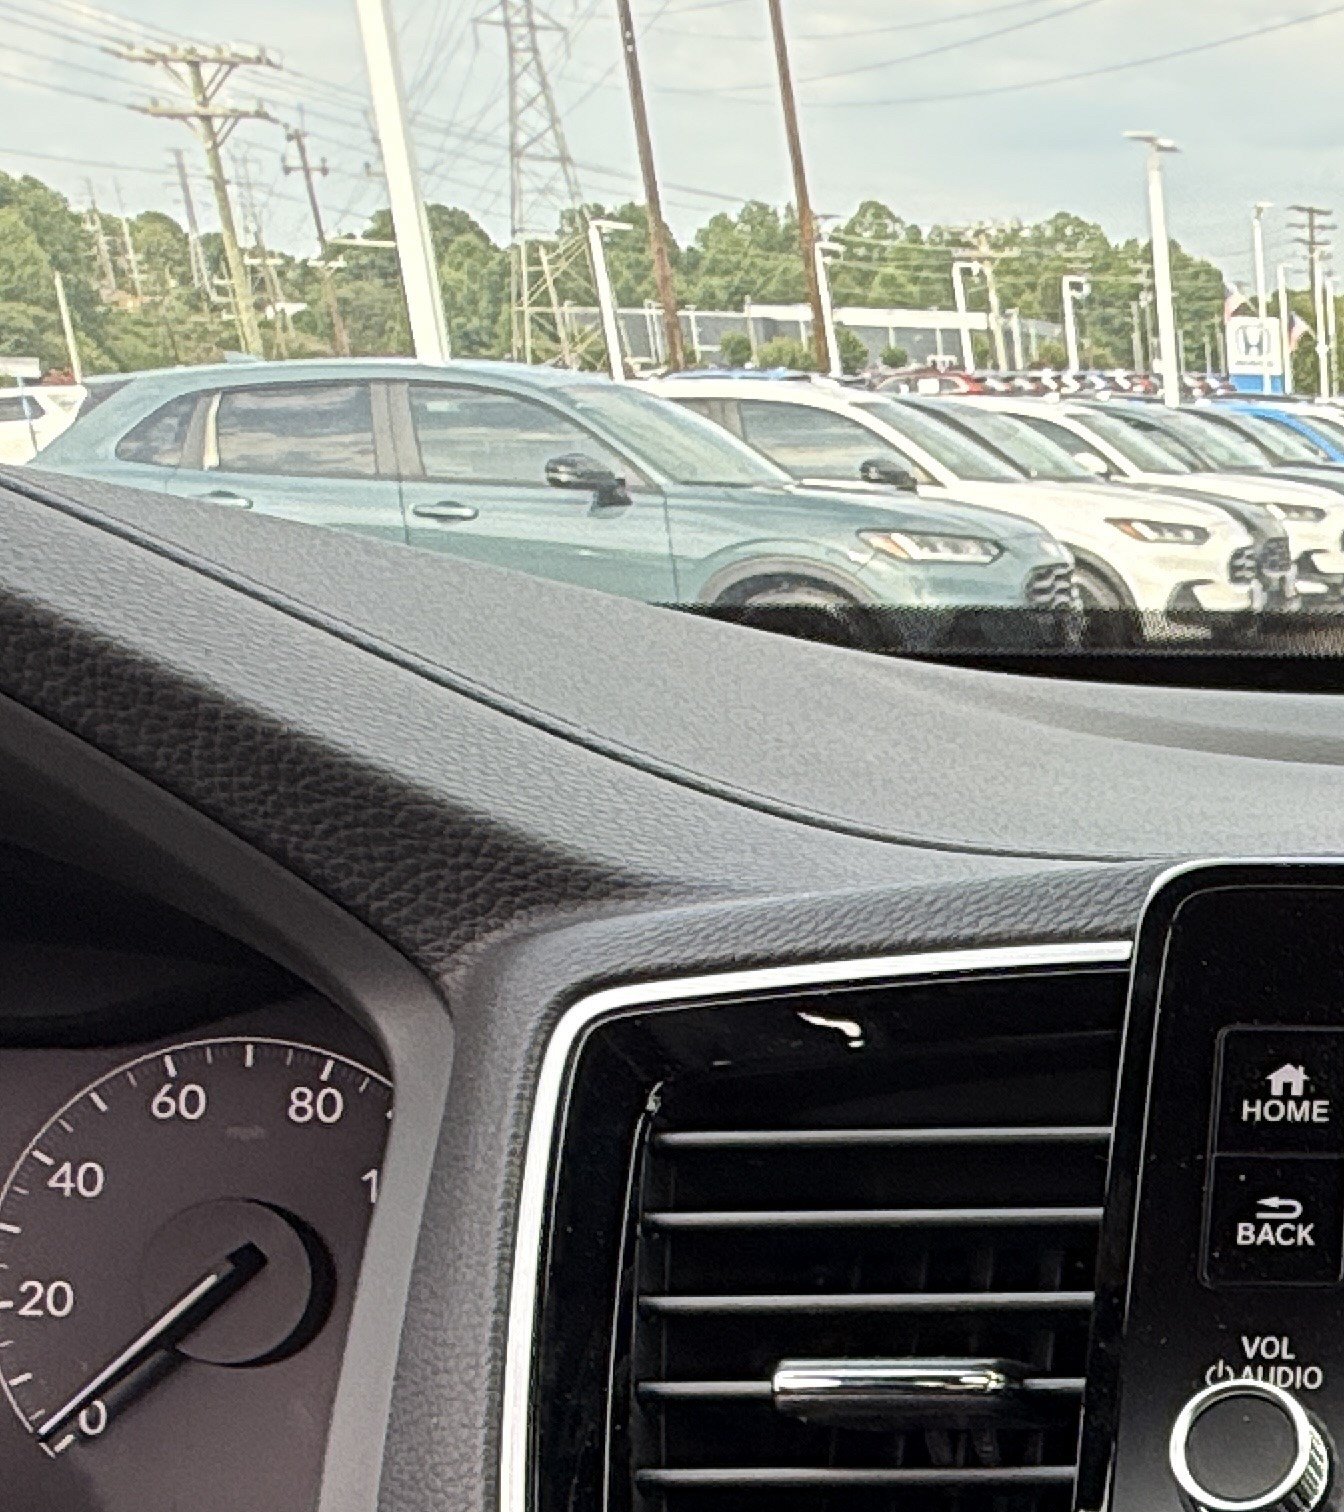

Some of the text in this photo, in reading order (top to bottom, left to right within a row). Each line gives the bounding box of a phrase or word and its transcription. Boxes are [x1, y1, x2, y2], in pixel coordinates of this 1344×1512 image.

[150, 1083, 206, 1120] 60
[288, 1086, 344, 1124] 80
[1241, 1098, 1330, 1123] HOME
[47, 1162, 105, 1198] 40
[1236, 1222, 1316, 1246] BACK
[17, 1280, 74, 1318] 20
[1241, 1335, 1296, 1360] VOL
[1241, 1365, 1323, 1390] AUDIO
[78, 1400, 108, 1435] 0
